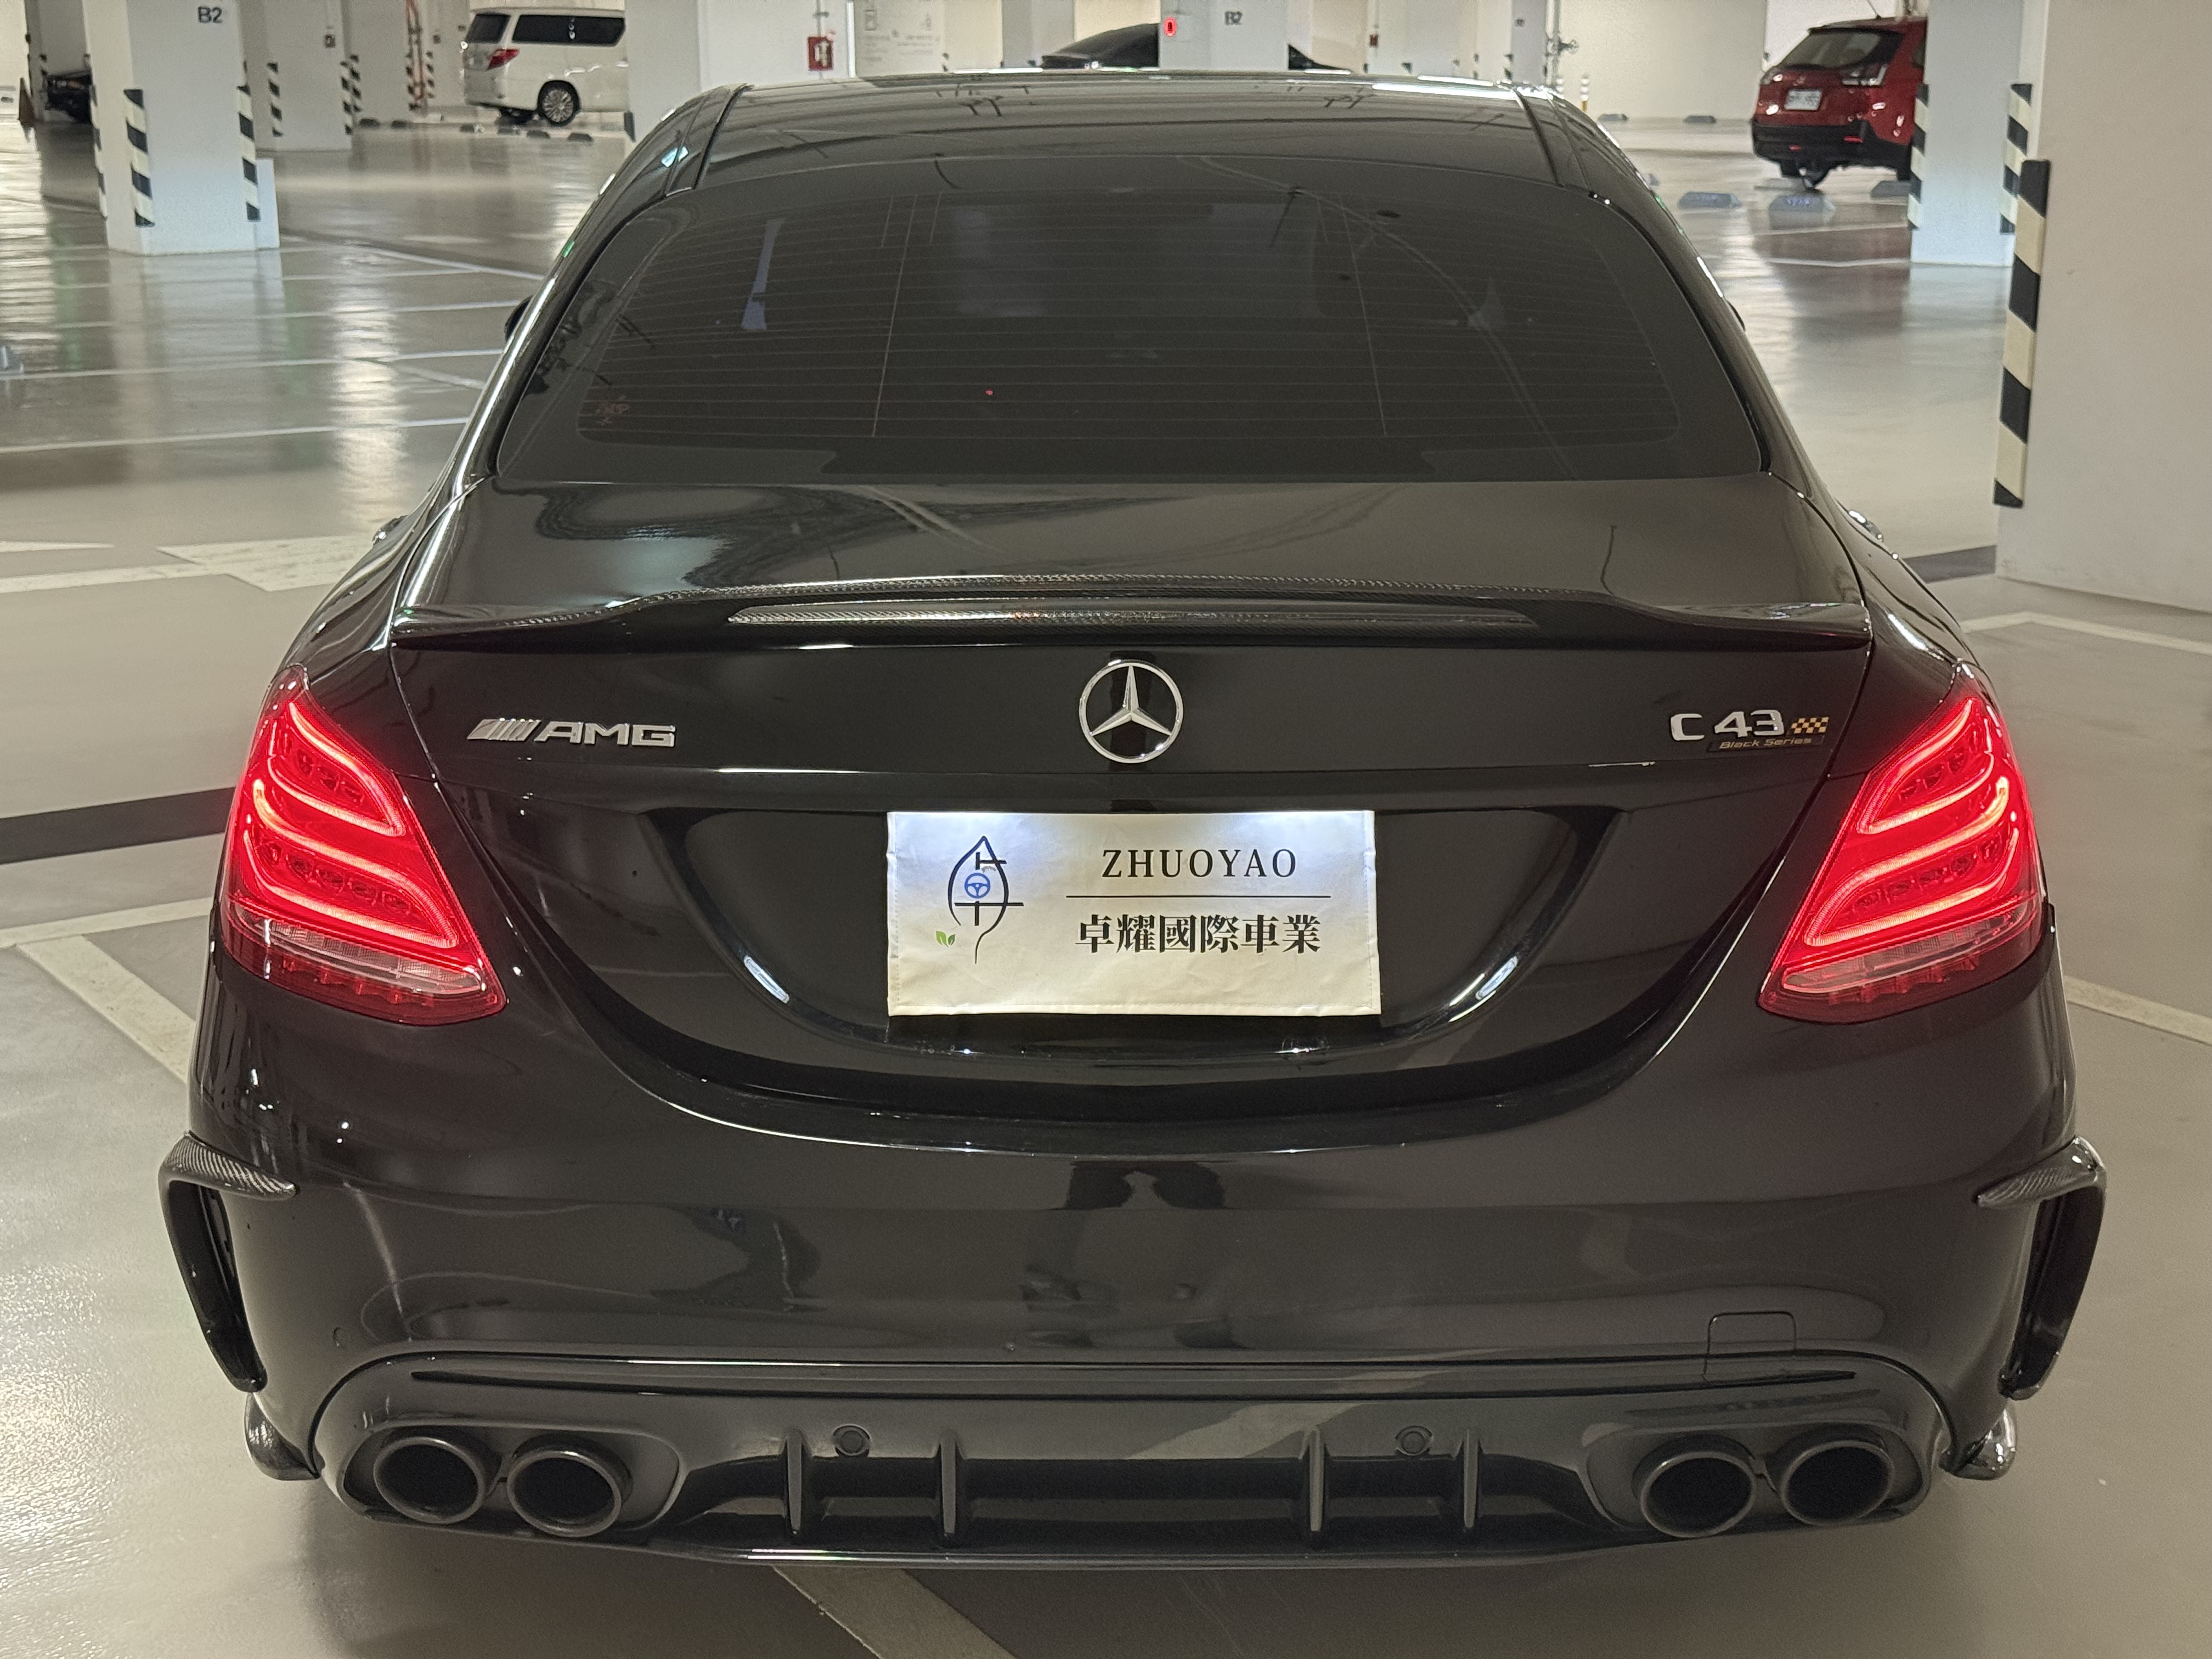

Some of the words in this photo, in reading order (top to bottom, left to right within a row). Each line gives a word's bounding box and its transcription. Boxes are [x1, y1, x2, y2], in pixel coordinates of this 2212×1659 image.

[198, 6, 223, 23] B2
[1225, 10, 1243, 25] B2
[534, 721, 676, 747] AMG
[1671, 713, 1705, 741] C
[1714, 710, 1784, 737] 43
[1719, 740, 1759, 749] Black
[1764, 737, 1812, 747] Series
[1102, 848, 1296, 878] ZHUOYAO
[1075, 913, 1321, 953] 卓耀國際車業
